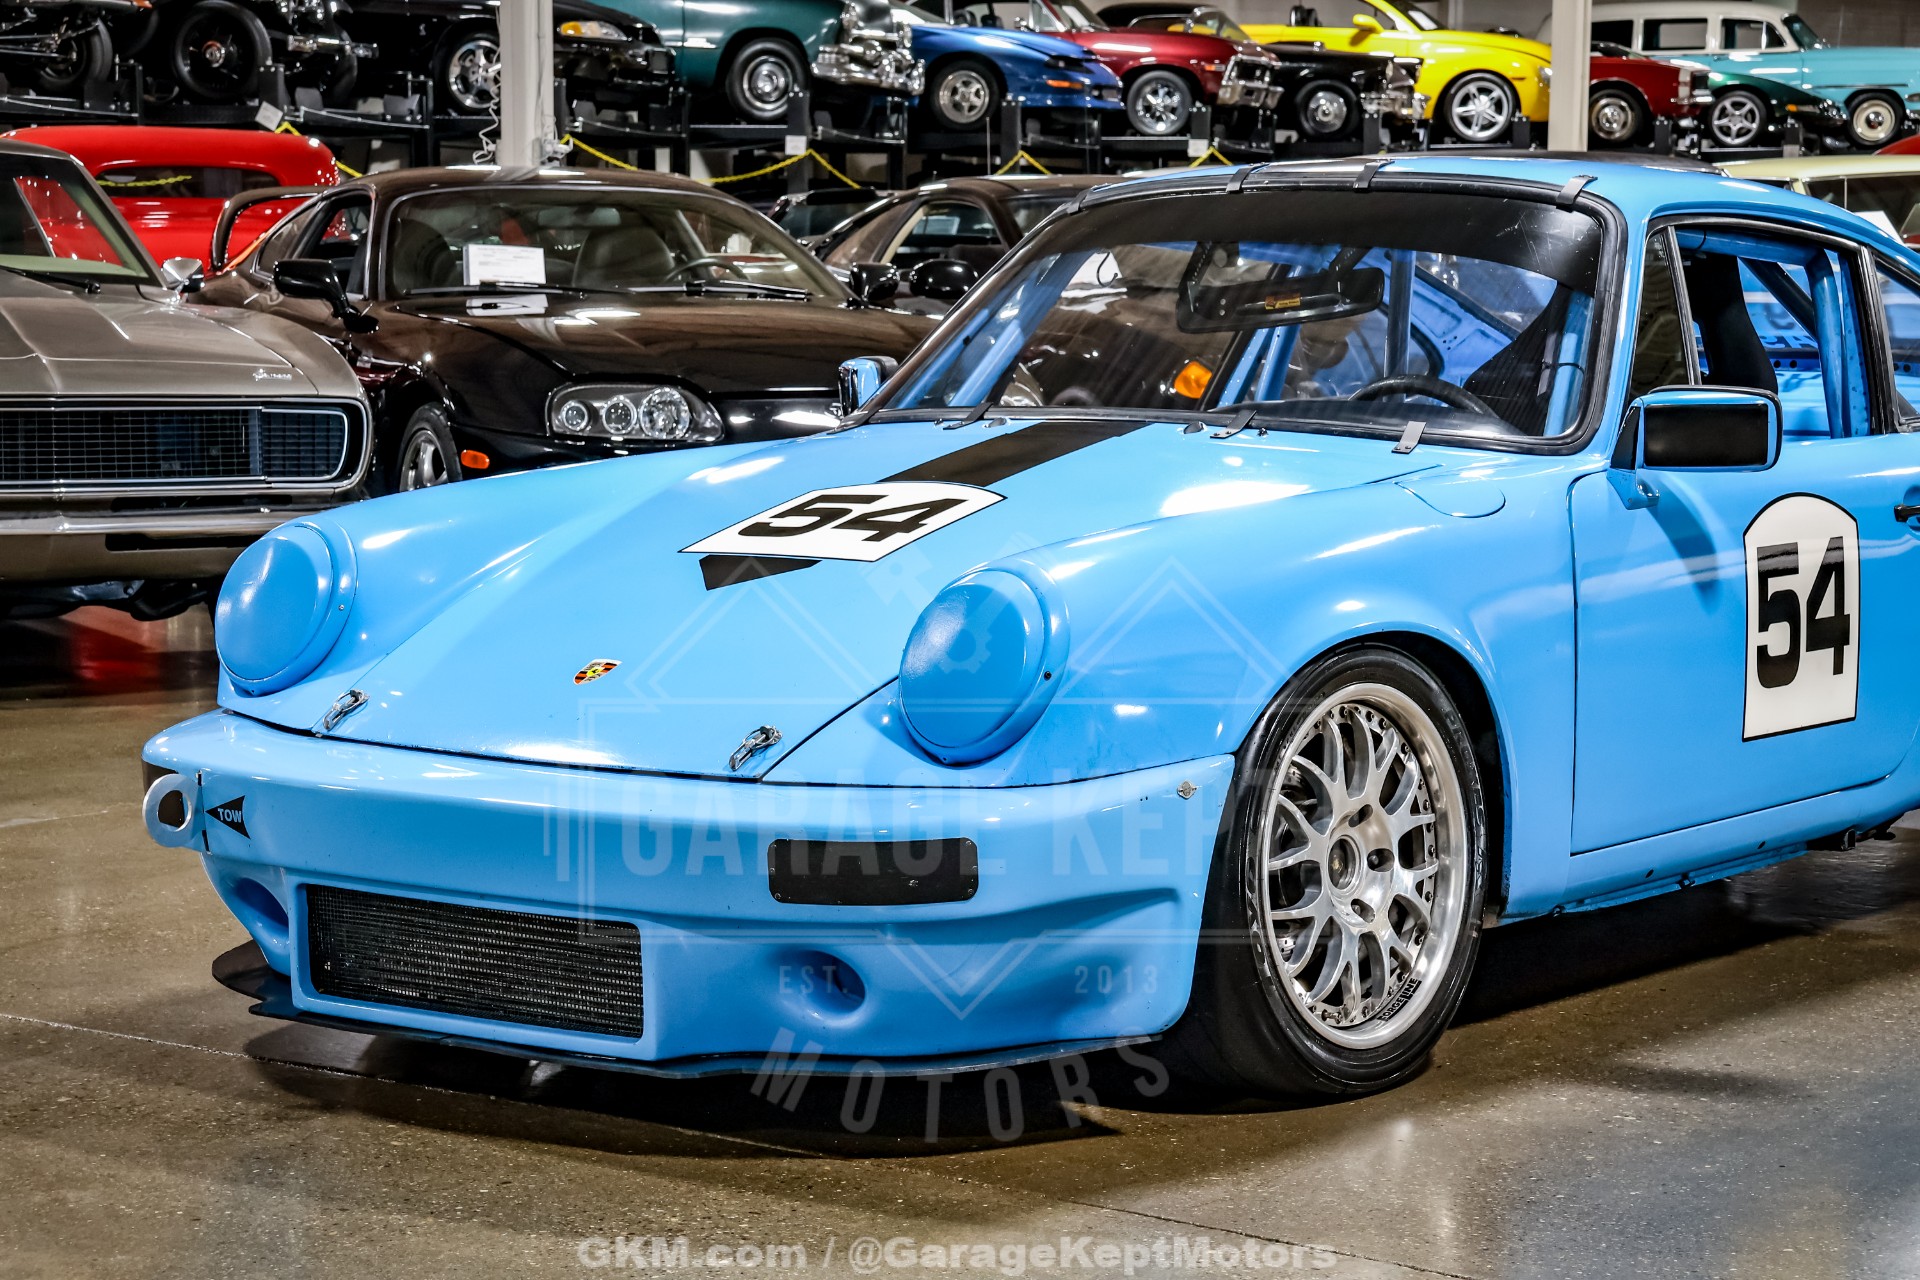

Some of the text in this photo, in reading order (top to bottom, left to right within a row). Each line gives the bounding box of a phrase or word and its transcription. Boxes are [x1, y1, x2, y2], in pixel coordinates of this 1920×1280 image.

[738, 494, 969, 542] 54
[1757, 536, 1850, 689] 54
[218, 808, 241, 823] TOW
[1377, 978, 1419, 1022] FORGELINE
